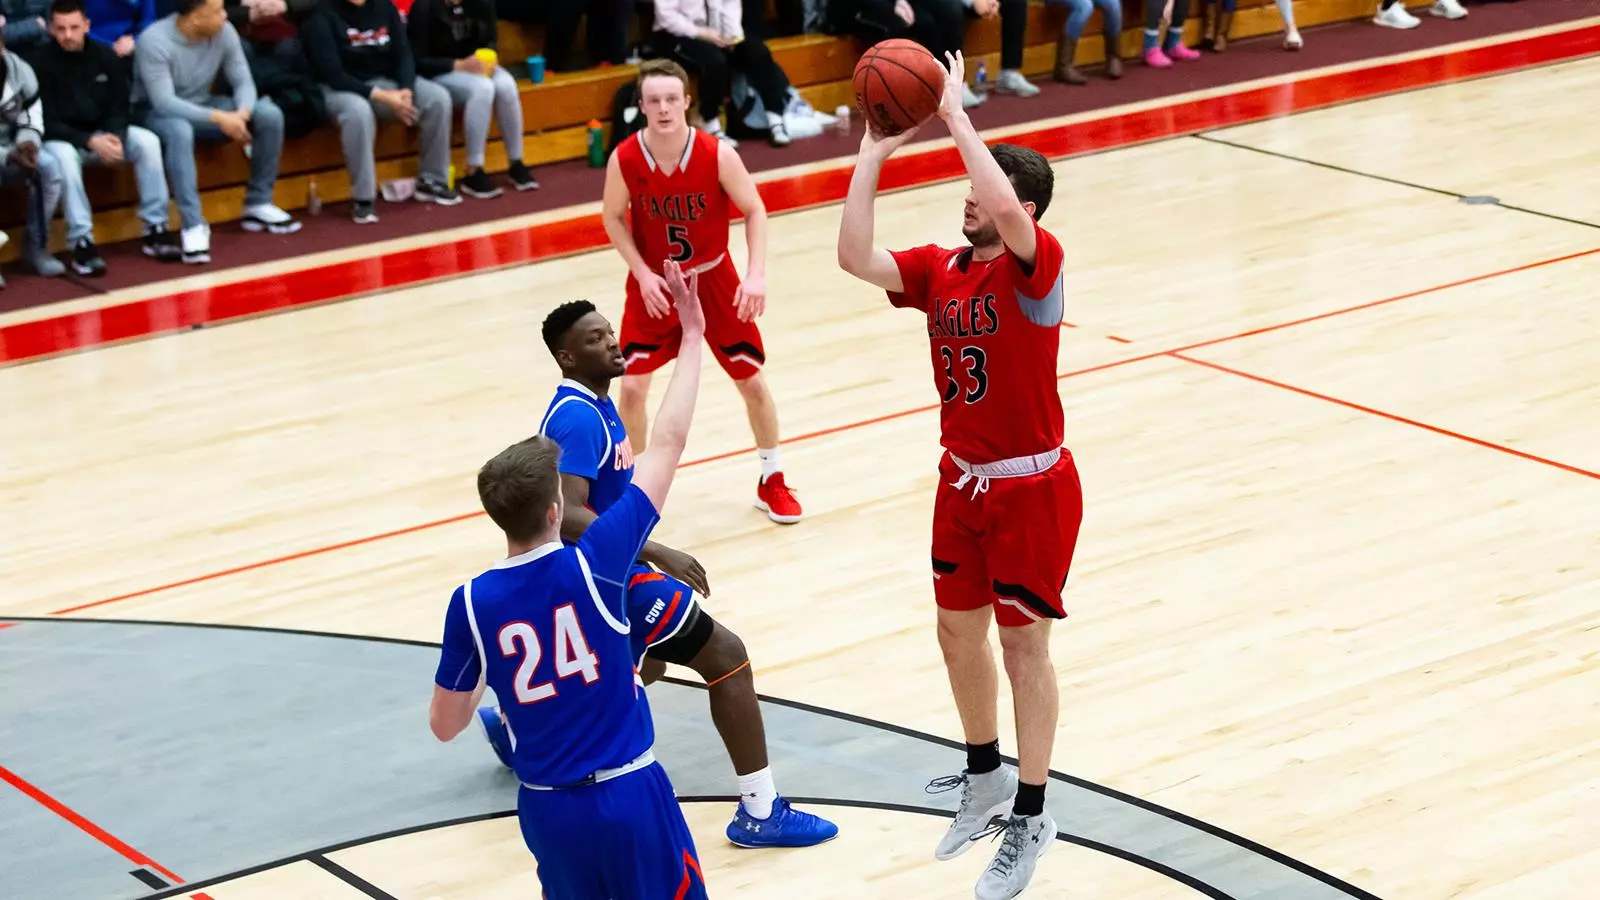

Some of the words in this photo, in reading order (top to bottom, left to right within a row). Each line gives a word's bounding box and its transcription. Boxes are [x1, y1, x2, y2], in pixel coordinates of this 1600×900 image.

[666, 224, 694, 264] 5
[941, 345, 988, 405] 33
[645, 597, 666, 624] CUW
[496, 601, 600, 705] 24
